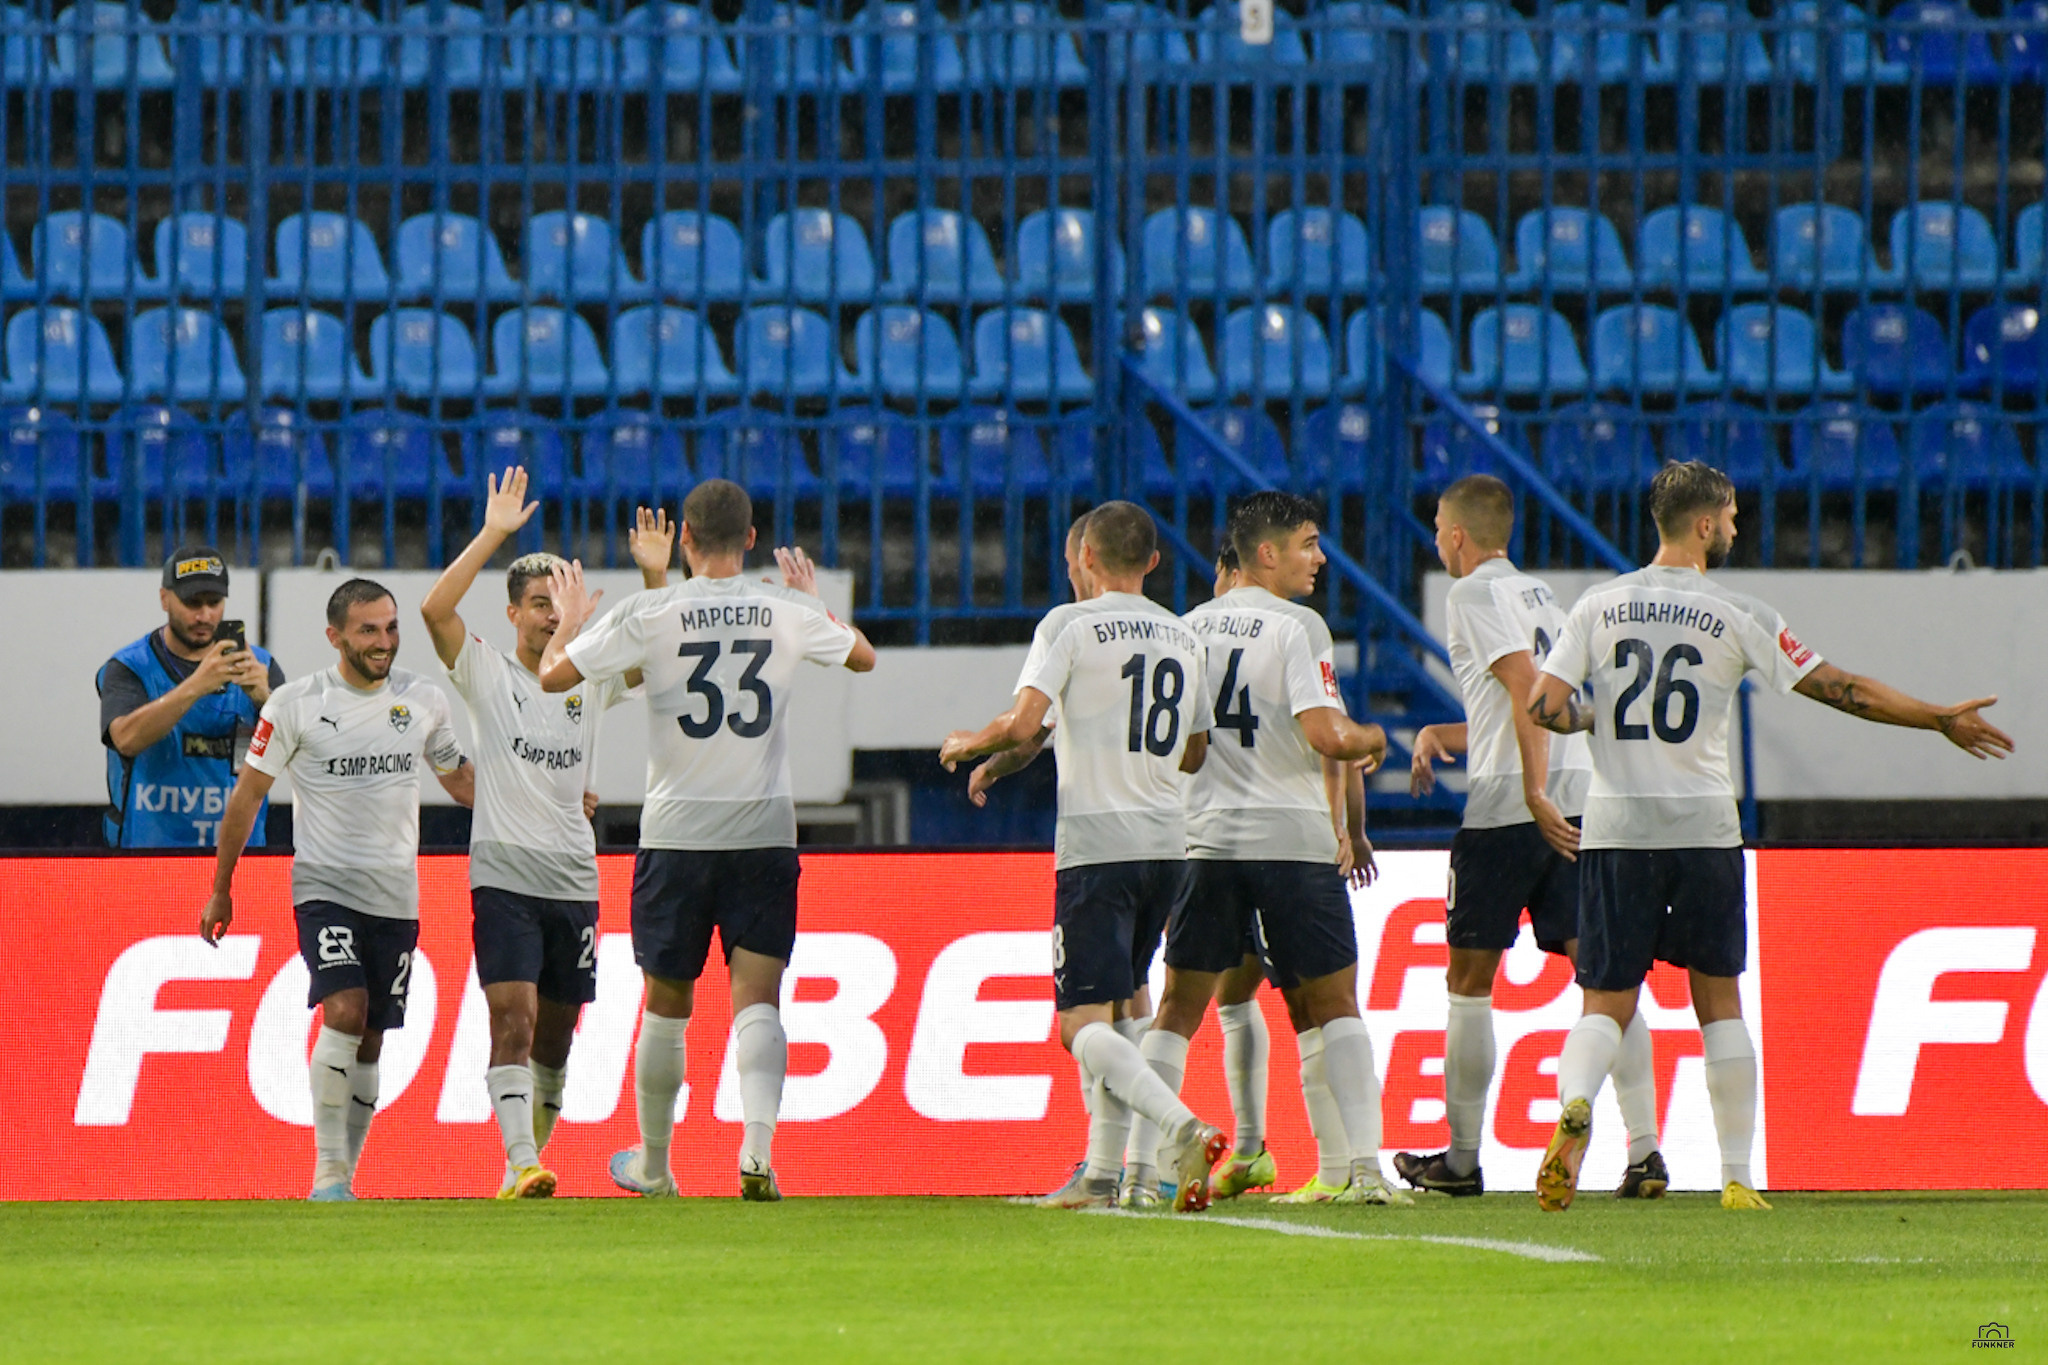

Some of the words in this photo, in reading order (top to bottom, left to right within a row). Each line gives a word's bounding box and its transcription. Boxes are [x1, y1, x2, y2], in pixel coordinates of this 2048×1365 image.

[680, 605, 772, 632] МАРСЕЛО
[1603, 602, 1725, 638] МЕЩАНИНОВ
[677, 639, 773, 740] 33
[1121, 653, 1184, 757] 18
[1614, 638, 1703, 744] 26
[340, 757, 367, 776] SMP
[369, 753, 412, 775] RACING
